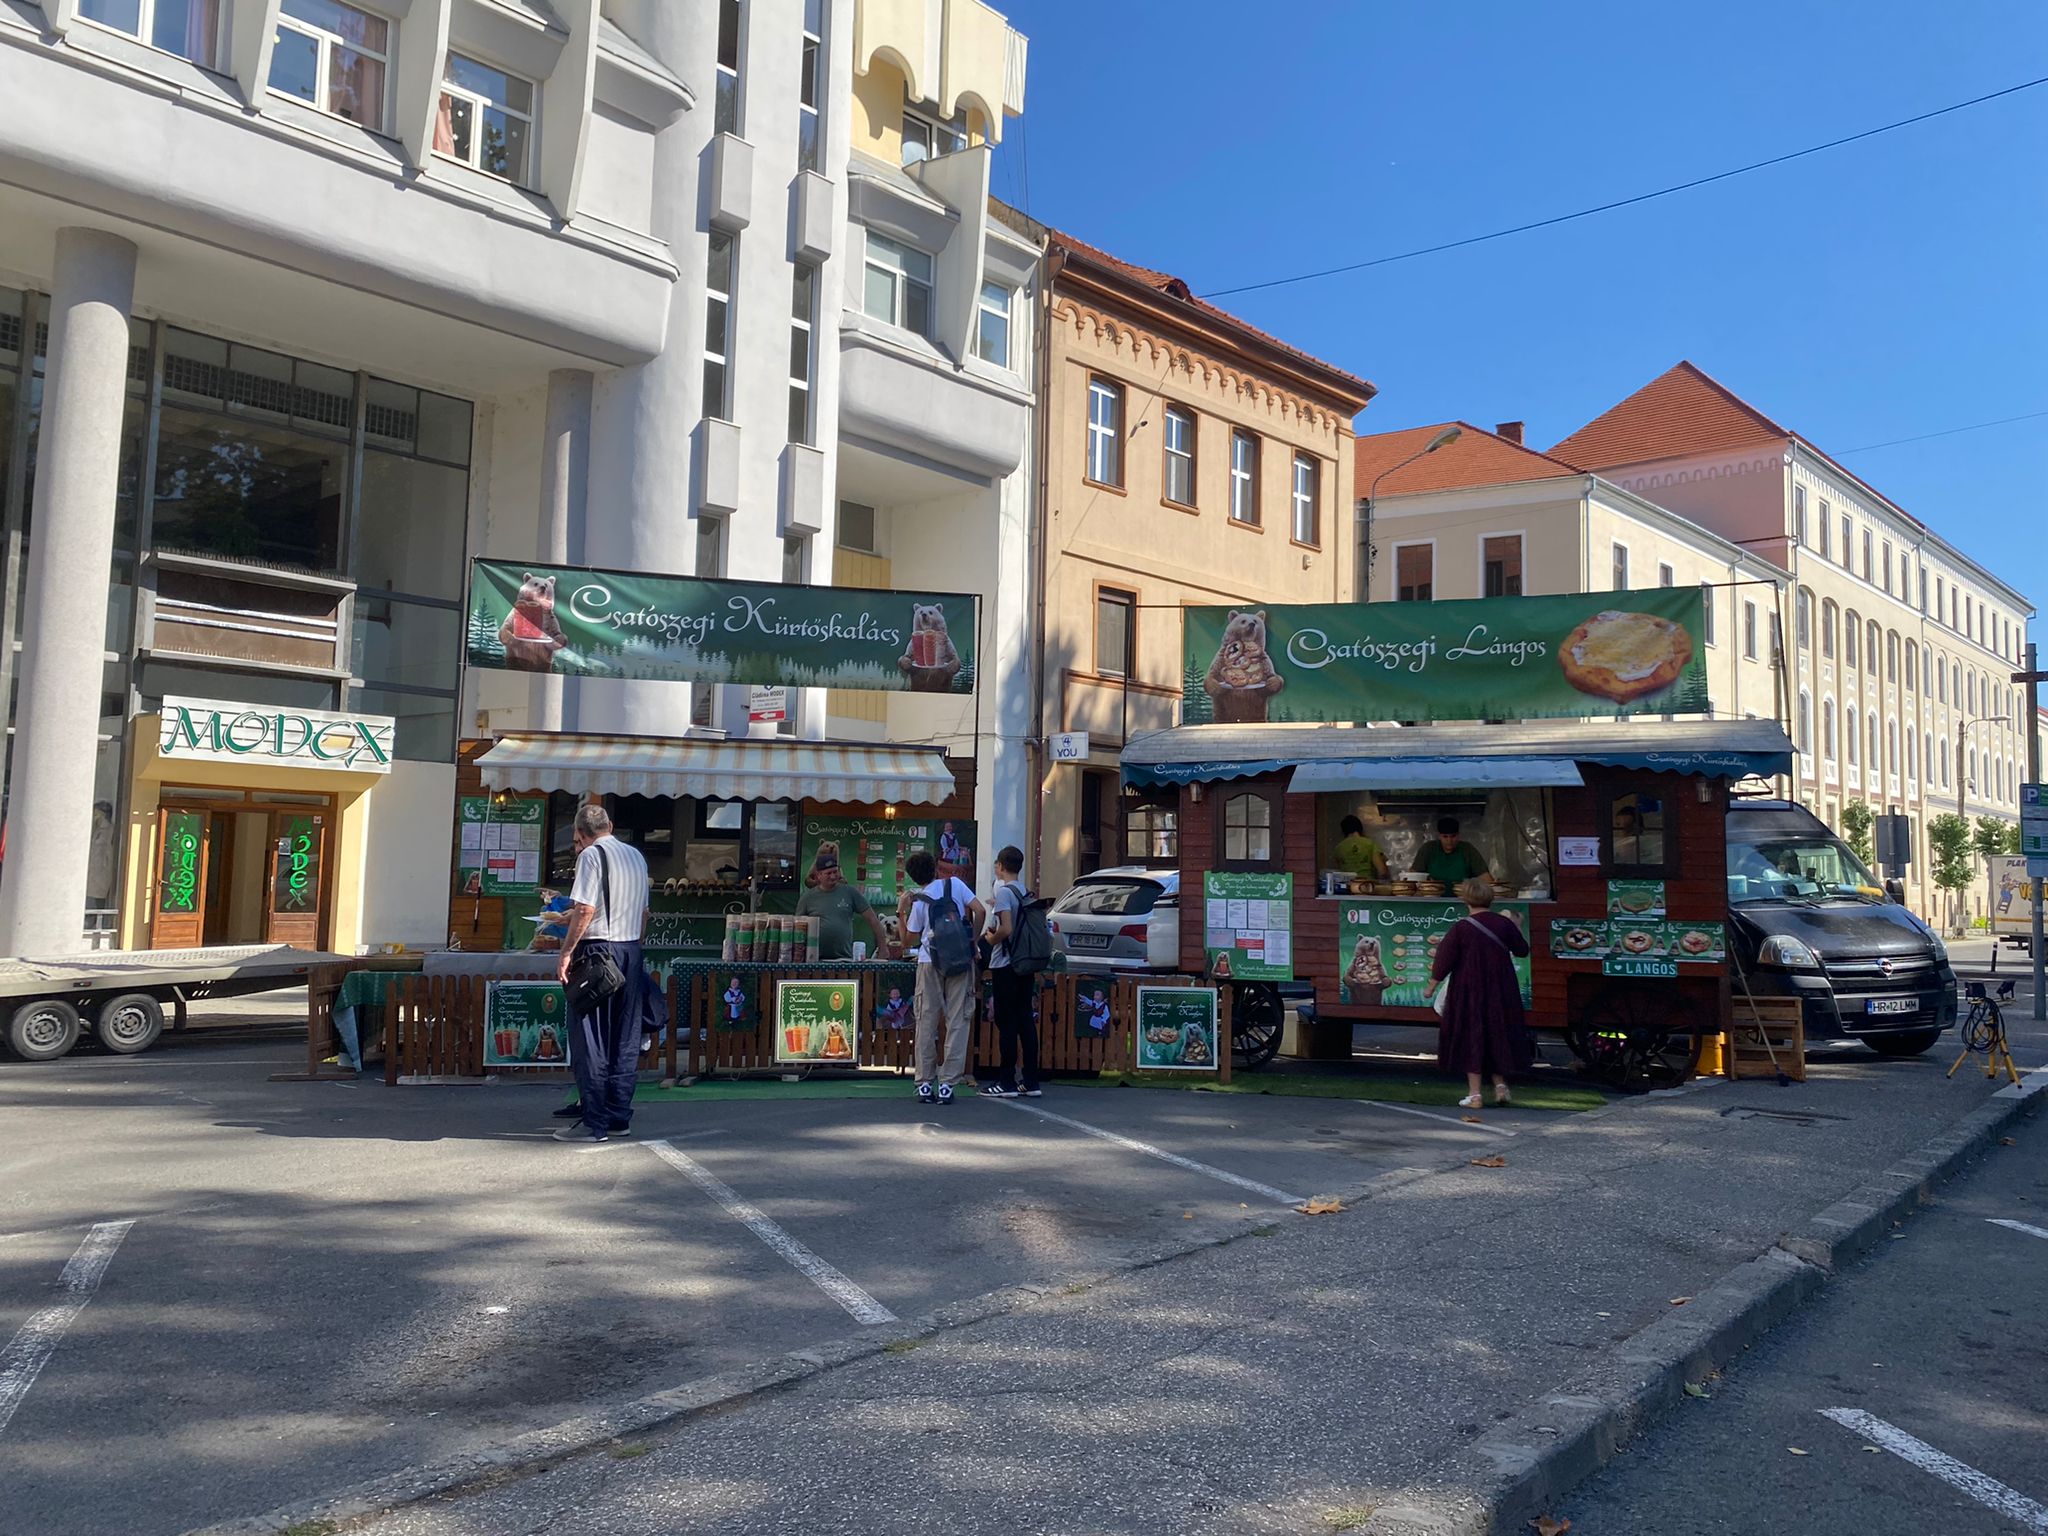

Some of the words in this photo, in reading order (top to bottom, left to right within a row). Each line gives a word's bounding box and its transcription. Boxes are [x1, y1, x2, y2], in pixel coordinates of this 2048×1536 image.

[569, 585, 715, 645] Csatószegi
[723, 596, 900, 647] Kürtőskalács
[1286, 628, 1436, 673] Csatószegi
[1445, 624, 1546, 666] Lángos
[1057, 748, 1078, 758] YOU
[1377, 909, 1435, 929] Csatószegi
[1626, 964, 1676, 975] LANGOS
[1873, 1002, 1886, 1011] HR
[1890, 1002, 1897, 1011] 12
